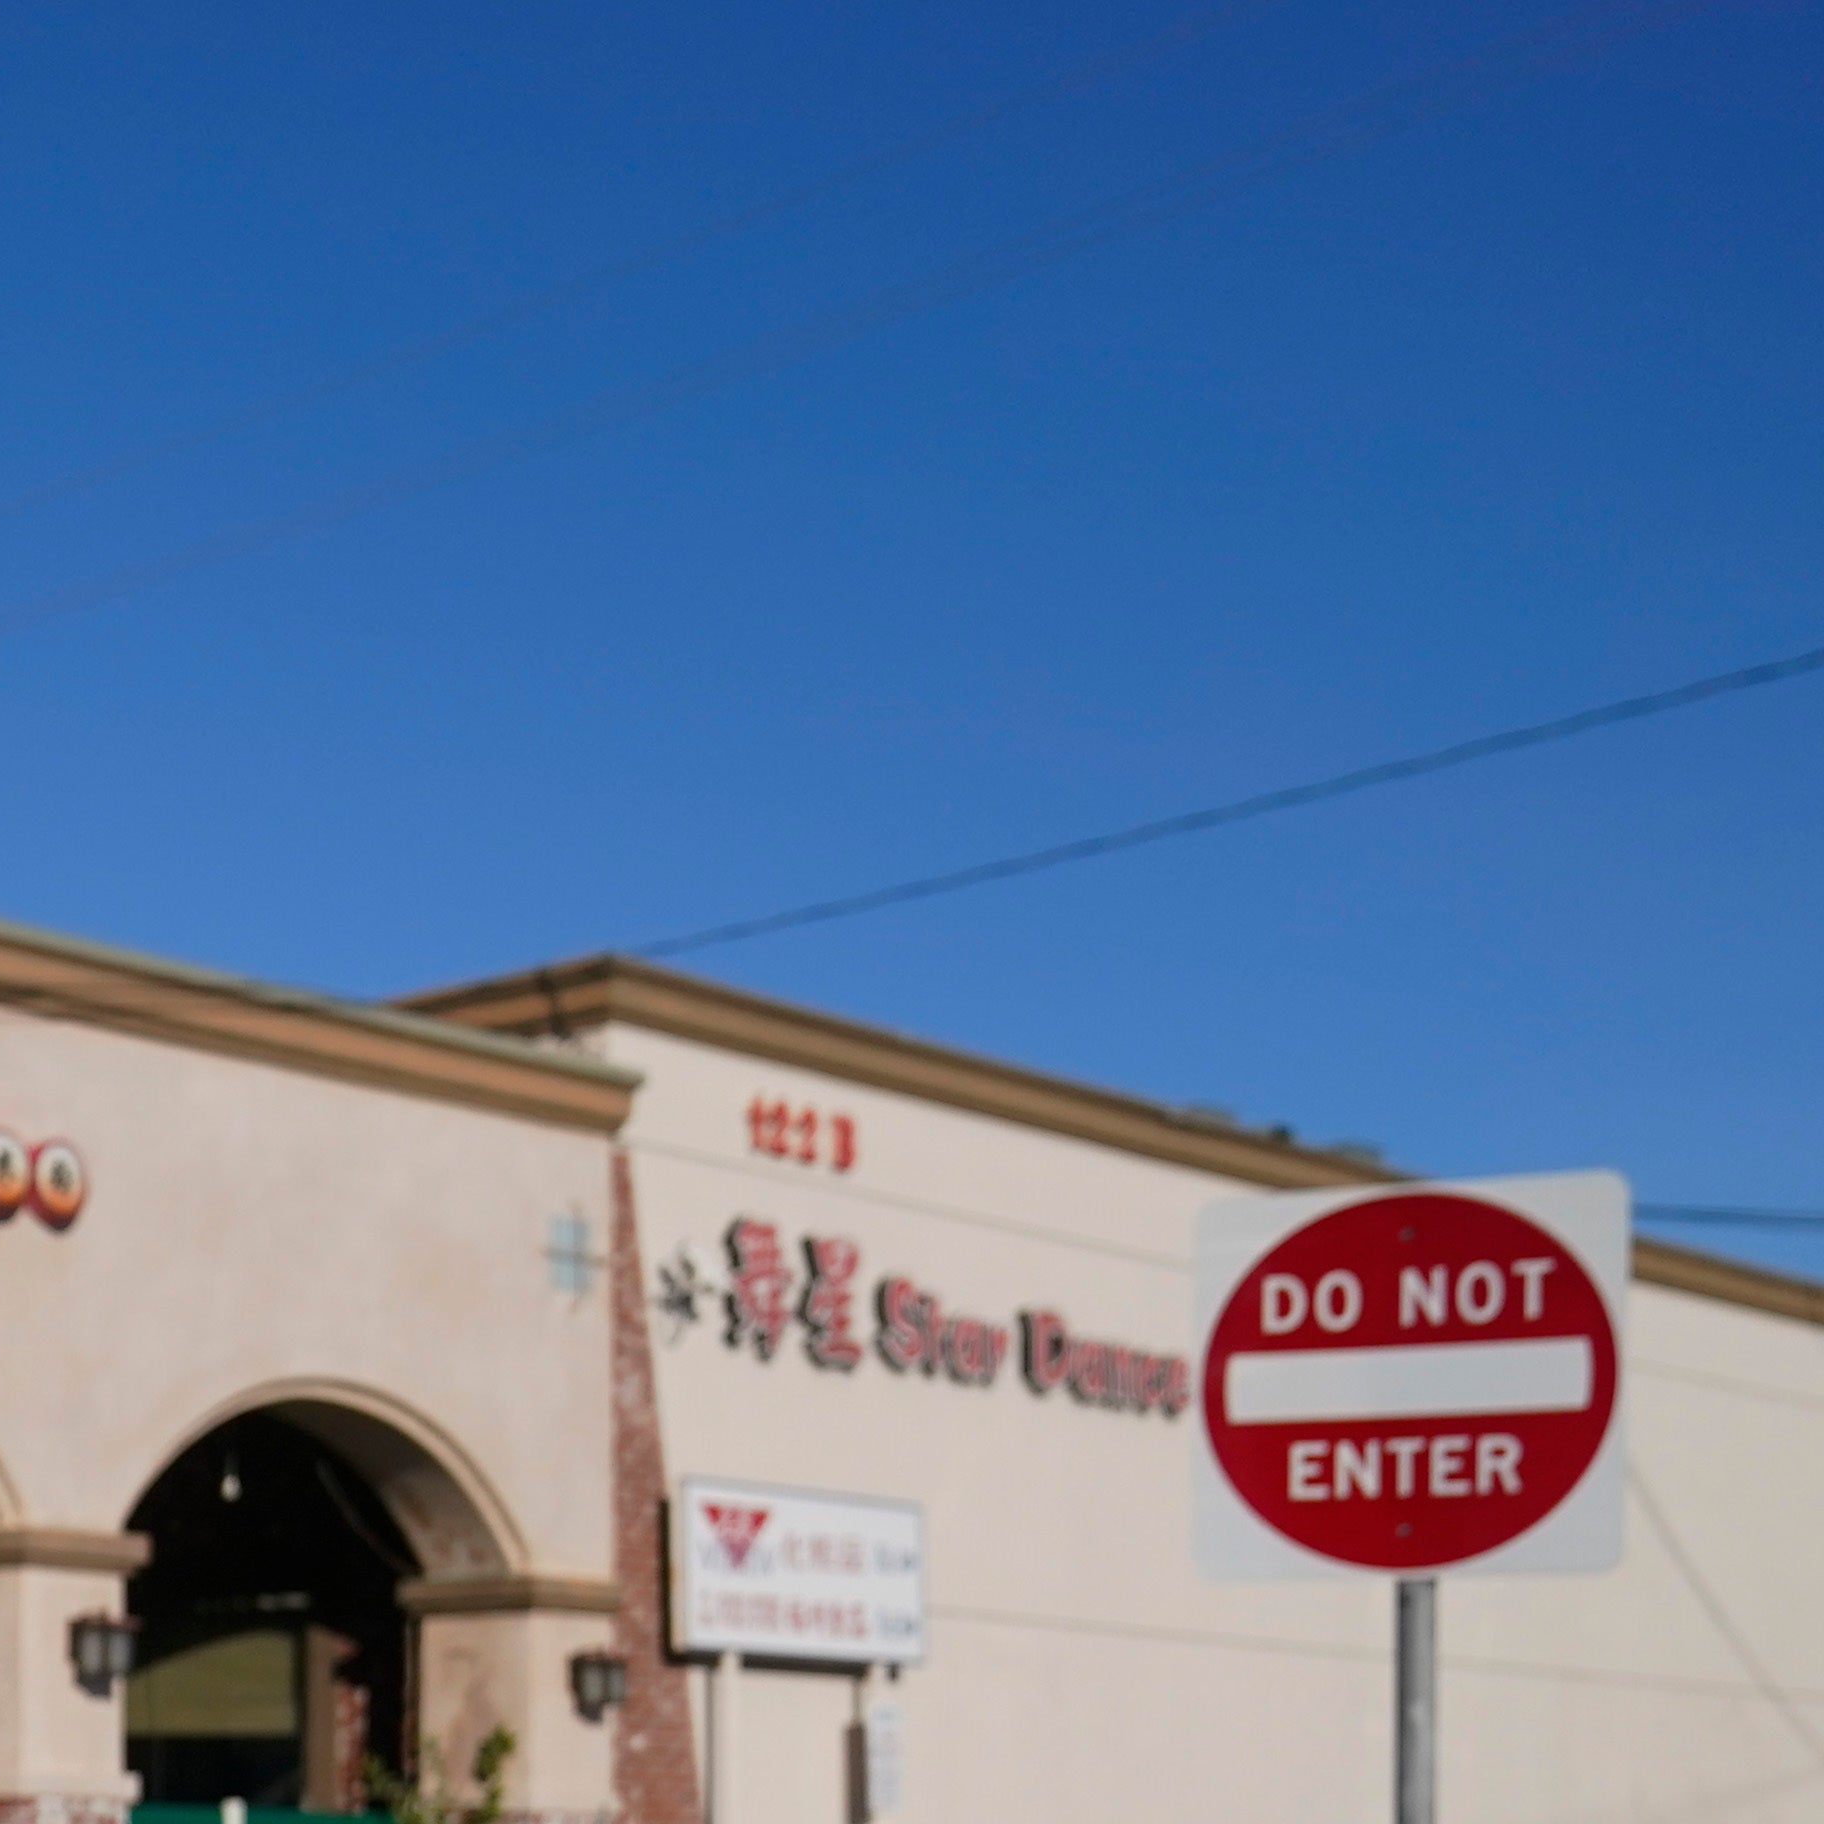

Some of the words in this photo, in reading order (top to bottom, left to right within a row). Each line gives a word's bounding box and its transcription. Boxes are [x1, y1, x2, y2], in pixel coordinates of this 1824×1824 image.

[1260, 1268, 1364, 1336] DO
[1397, 1256, 1557, 1329] NOT
[1287, 1432, 1524, 1502] ENTER
